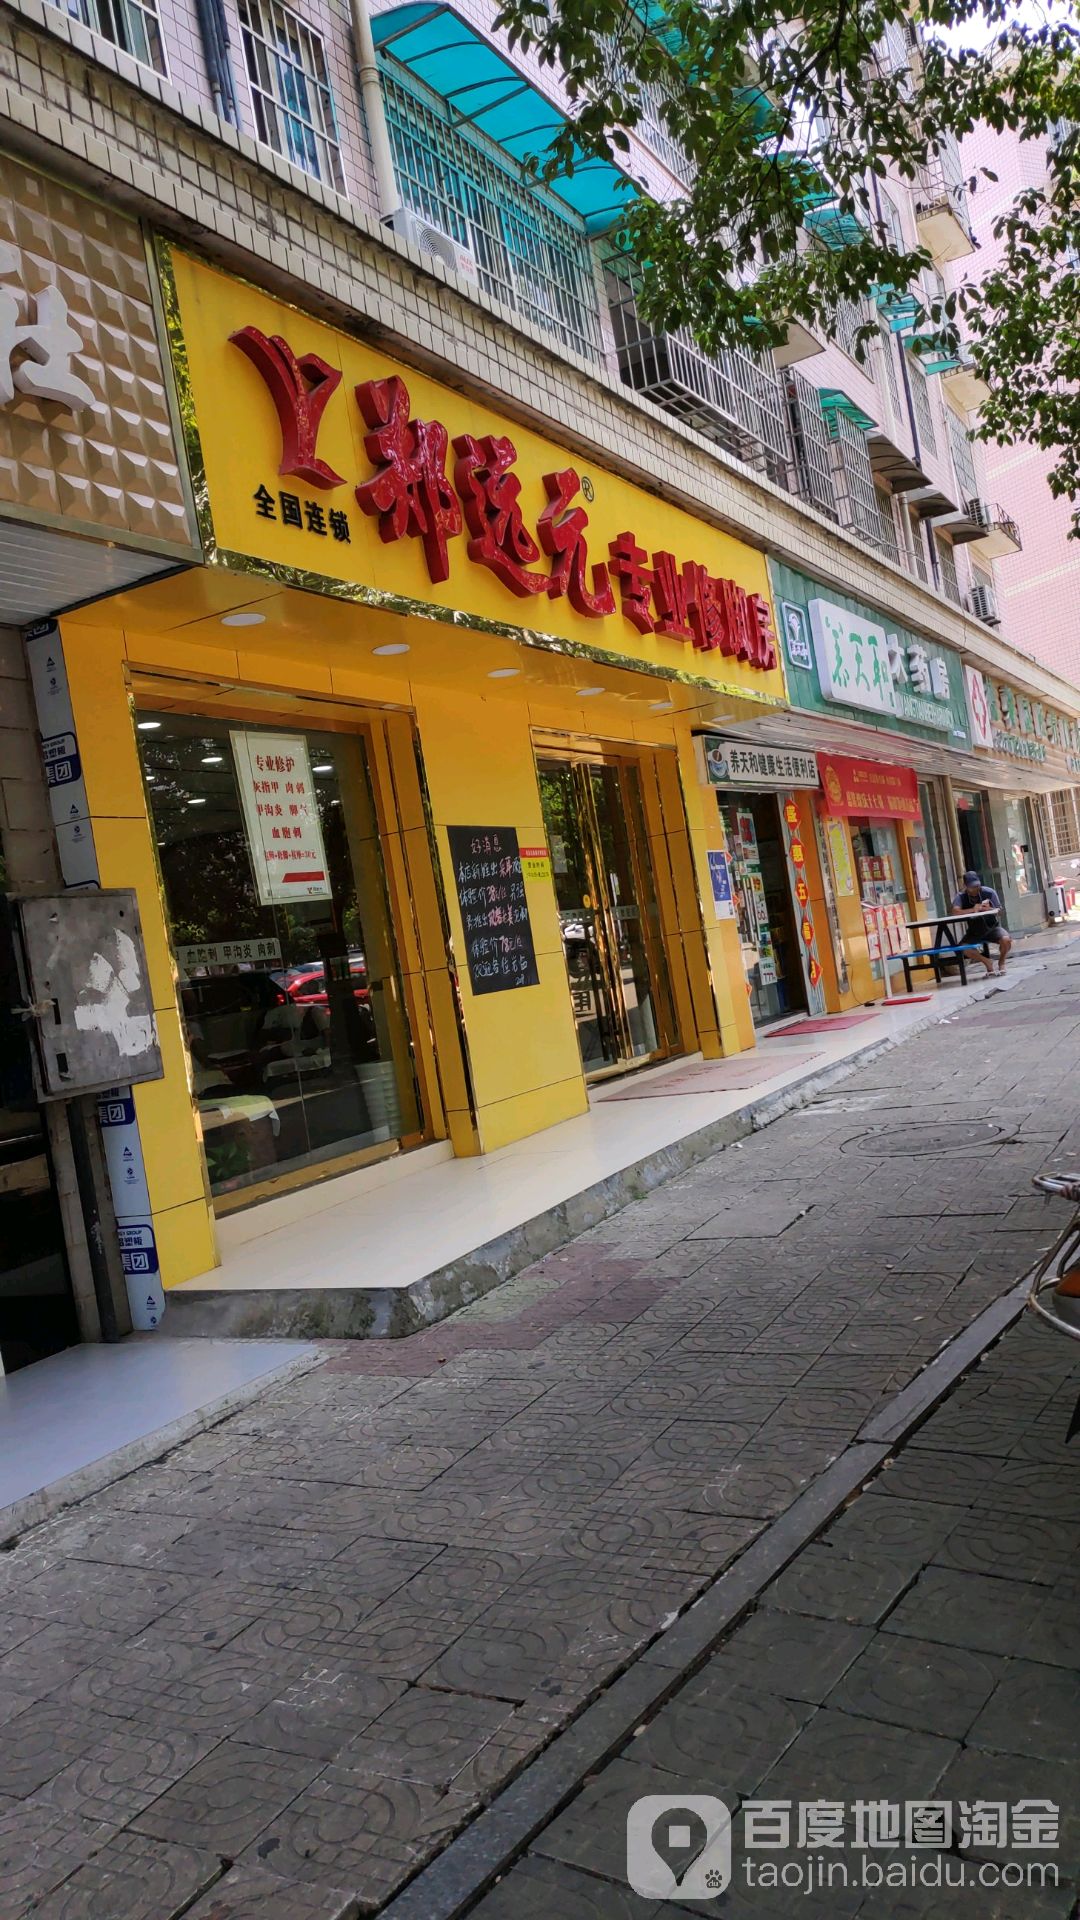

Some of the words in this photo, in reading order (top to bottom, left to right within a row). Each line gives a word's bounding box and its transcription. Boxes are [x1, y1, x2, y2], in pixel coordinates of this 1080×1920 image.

[253, 484, 352, 544] 全国连锁
[256, 754, 295, 773] 专业修护
[729, 748, 816, 780] 养天和健康生活便利店
[470, 834, 502, 855] 好消息
[223, 944, 253, 960] 甲沟炎
